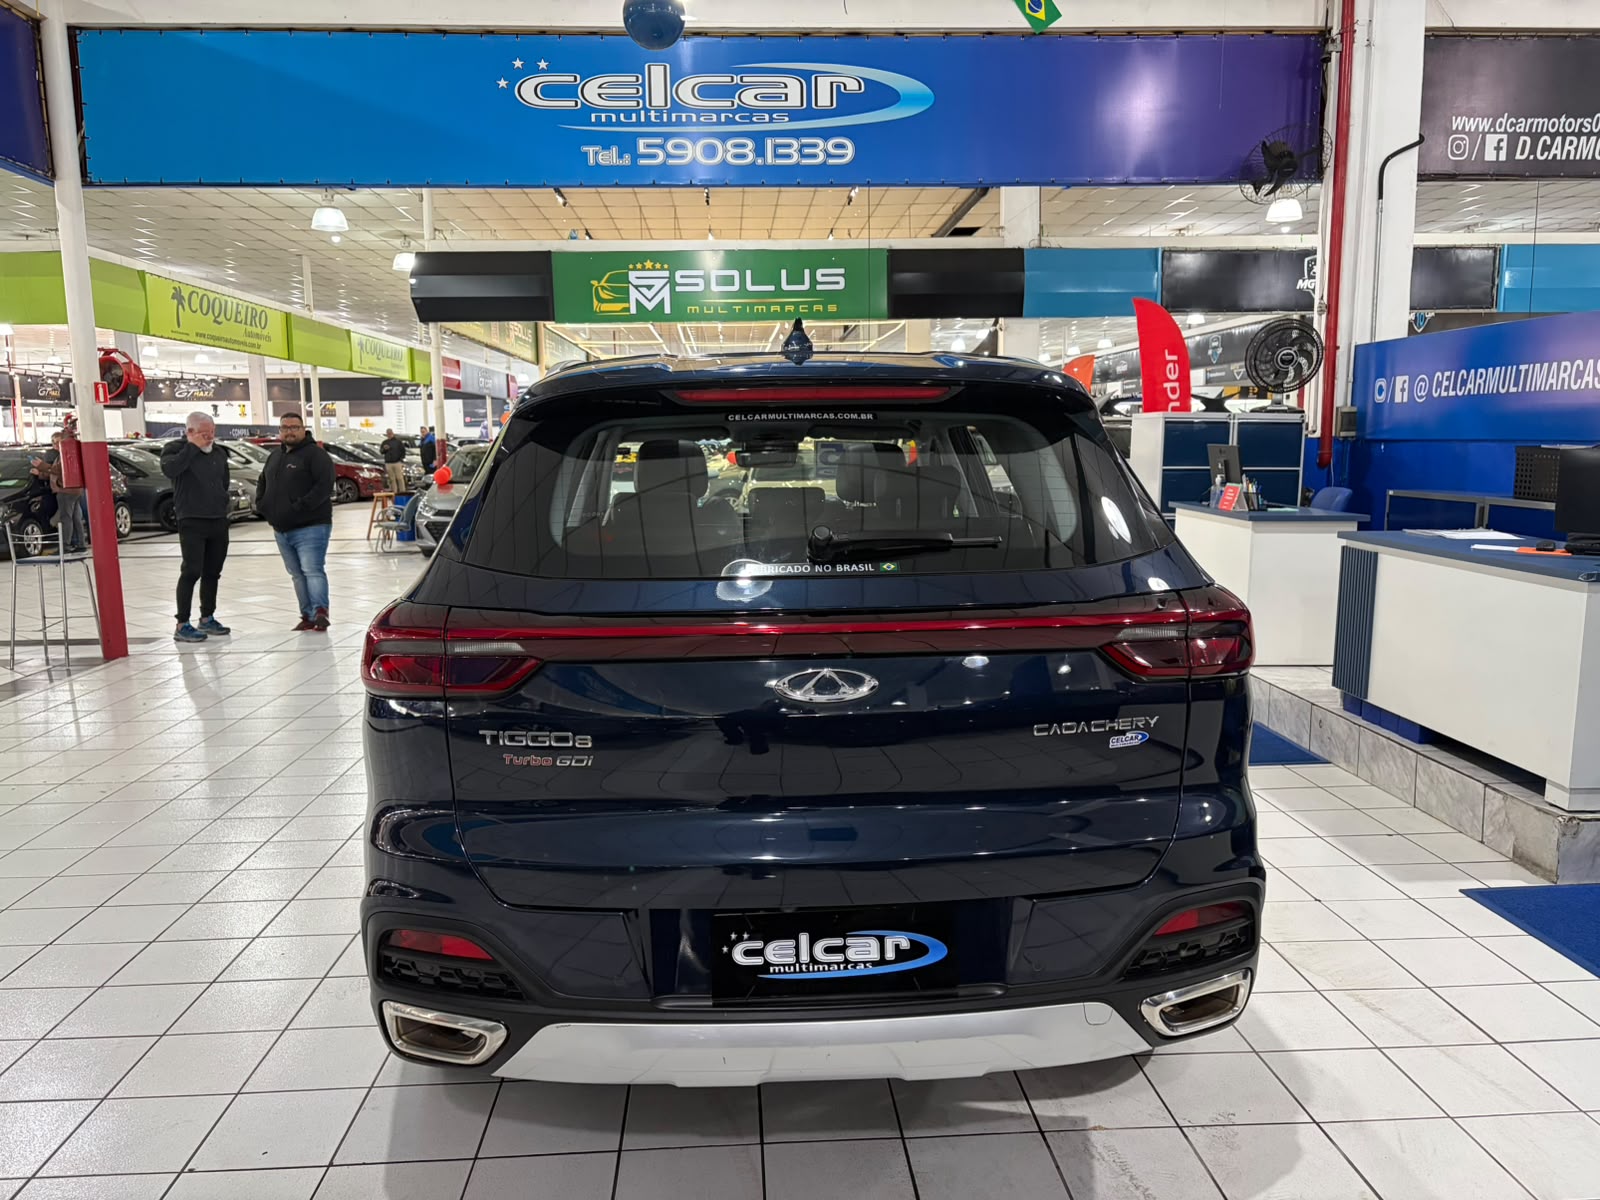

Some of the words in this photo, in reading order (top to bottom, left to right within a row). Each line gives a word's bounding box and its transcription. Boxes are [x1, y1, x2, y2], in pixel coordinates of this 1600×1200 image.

[514, 63, 865, 110] celcar
[590, 110, 790, 123] multimarcas
[636, 137, 856, 167] 5908.1339
[675, 268, 846, 292] SOLUS
[187, 290, 269, 330] COQUEIRO
[687, 304, 838, 314] MULTIMARCAS
[382, 386, 403, 395] CR
[728, 413, 874, 421] CELCARMULTIMARCAS.COM.BR
[815, 564, 832, 573] NO
[836, 563, 875, 572] BRASIL
[503, 754, 553, 766] Turbo
[732, 932, 911, 966] celcar
[769, 962, 873, 974] multimarcas
